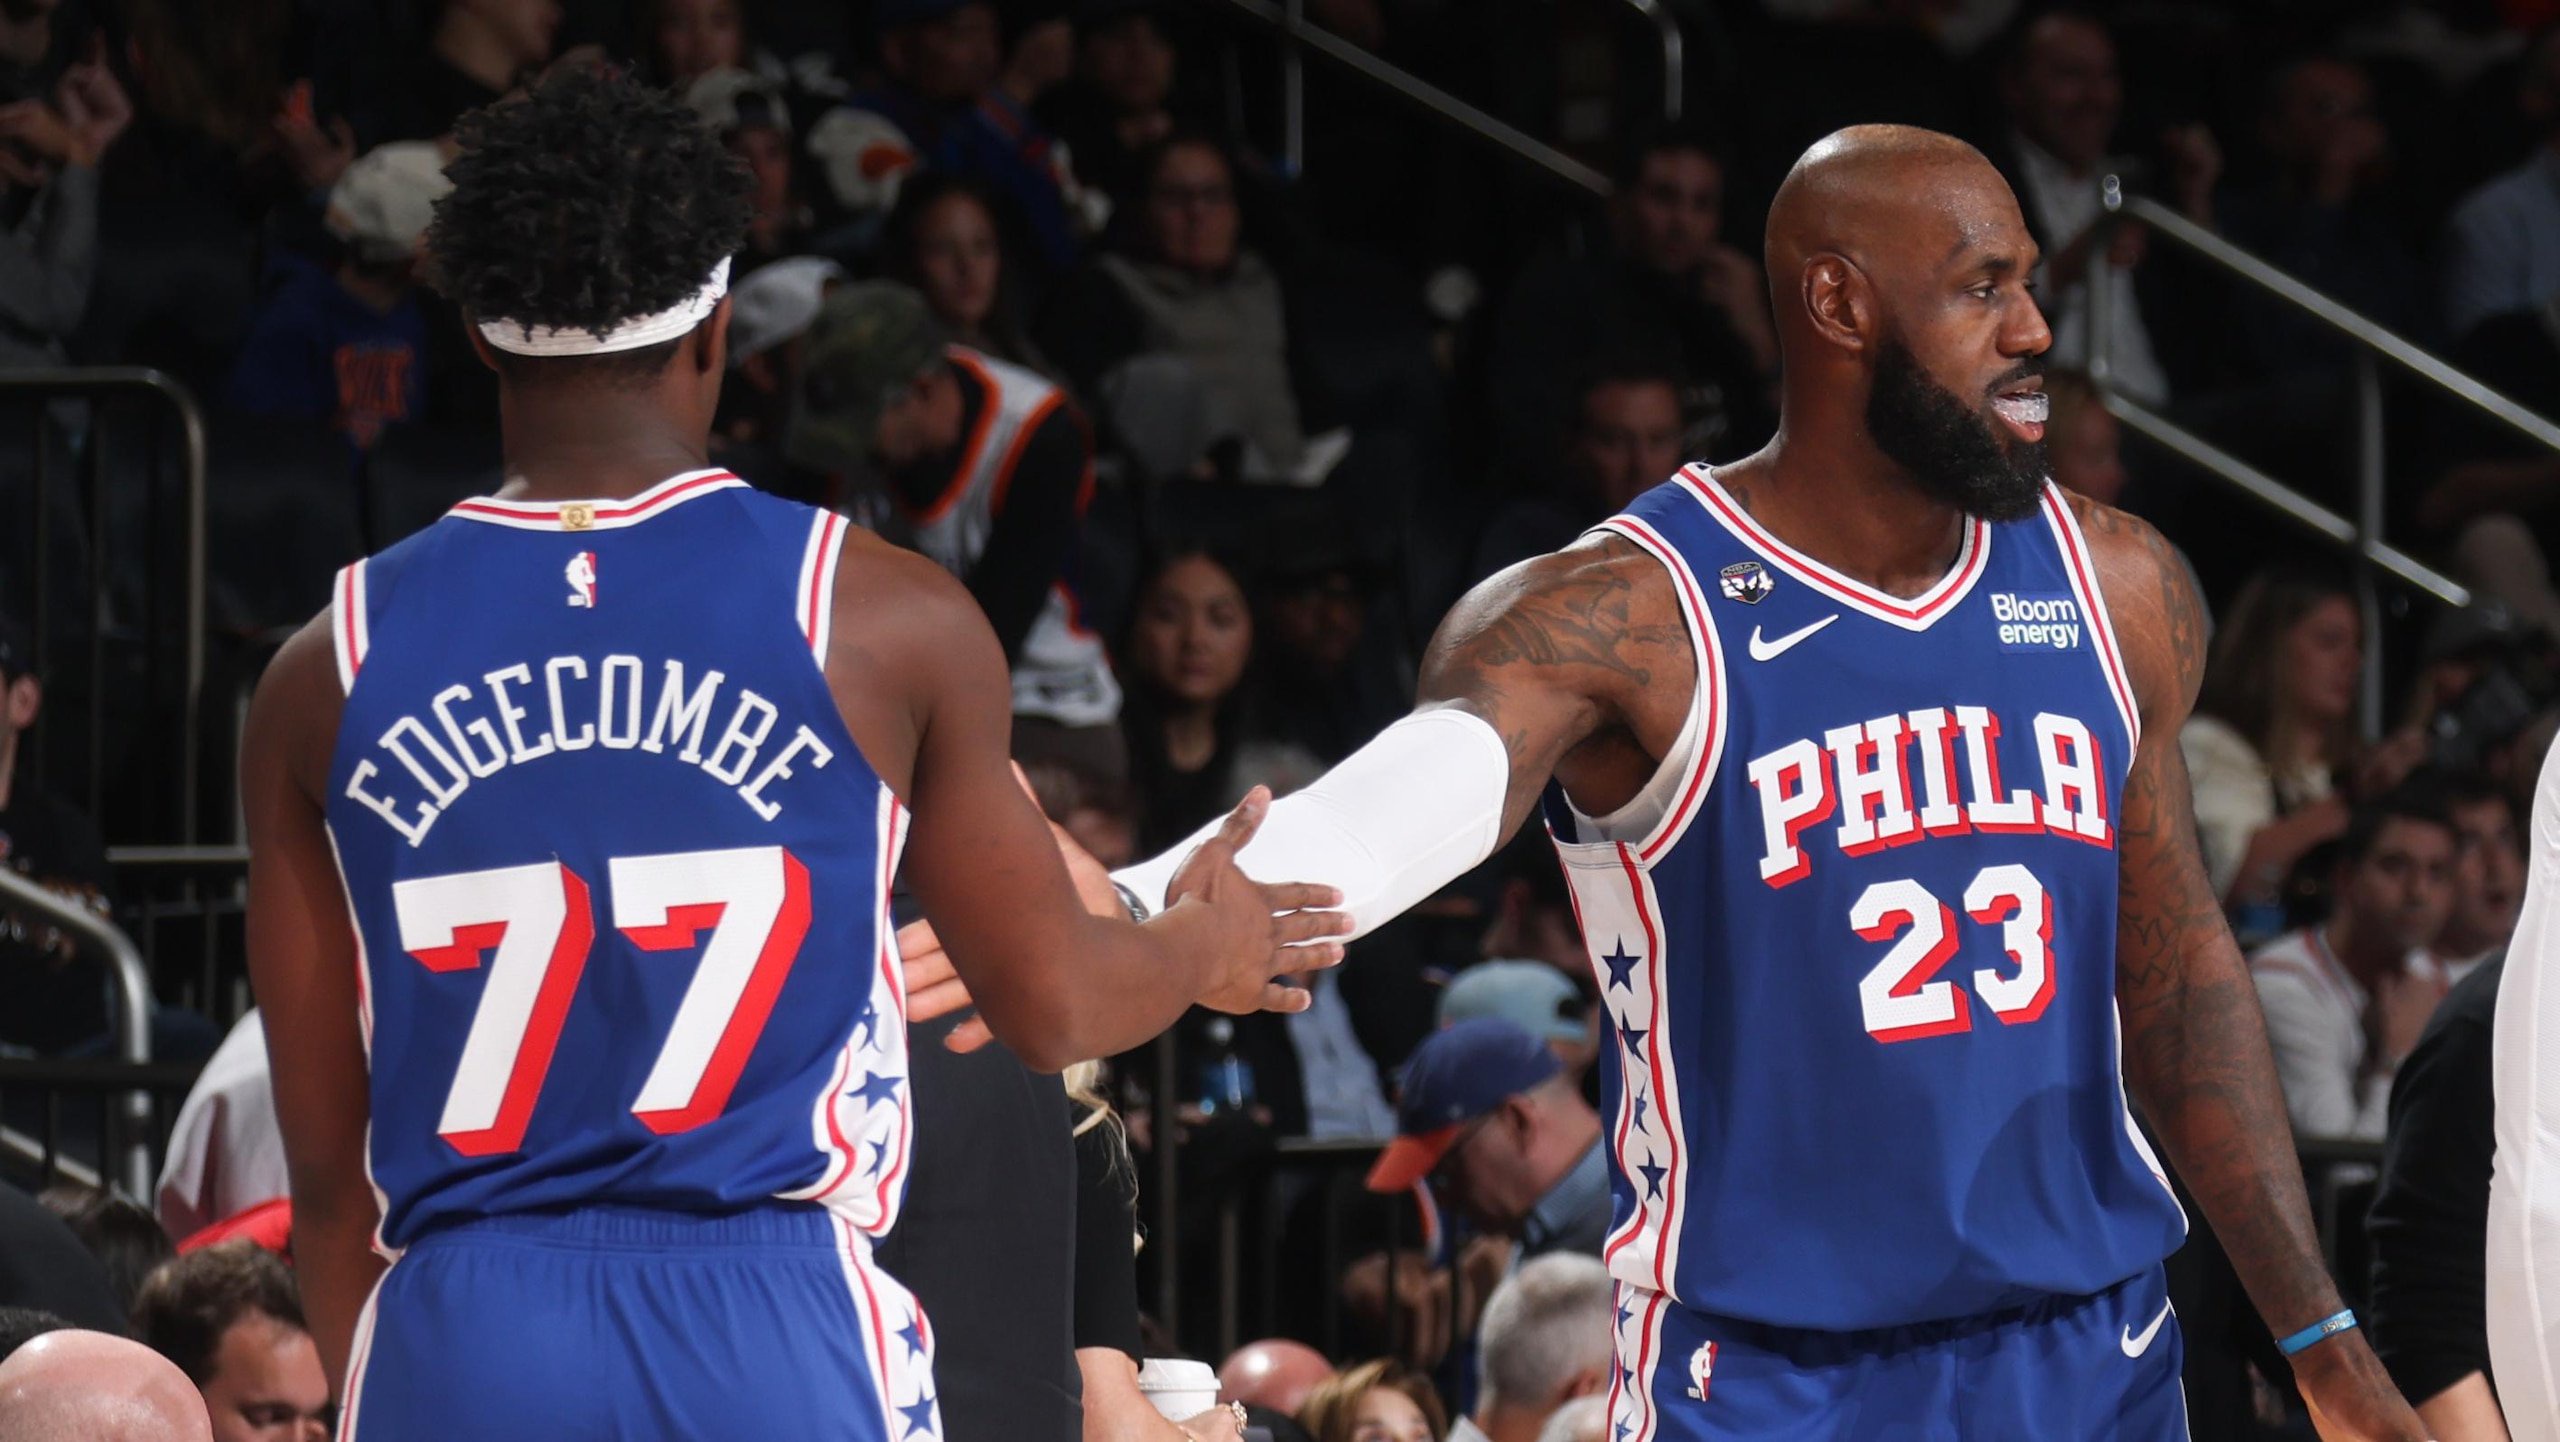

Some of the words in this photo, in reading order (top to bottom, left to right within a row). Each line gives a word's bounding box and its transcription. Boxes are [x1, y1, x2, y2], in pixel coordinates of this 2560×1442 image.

[1990, 593, 2077, 621] Bloom
[1999, 623, 2079, 649] energy
[345, 654, 833, 847] EDGECOMBE
[1747, 705, 2113, 889] PHILA
[392, 846, 812, 1157] 77
[1849, 863, 2056, 1043] 23
